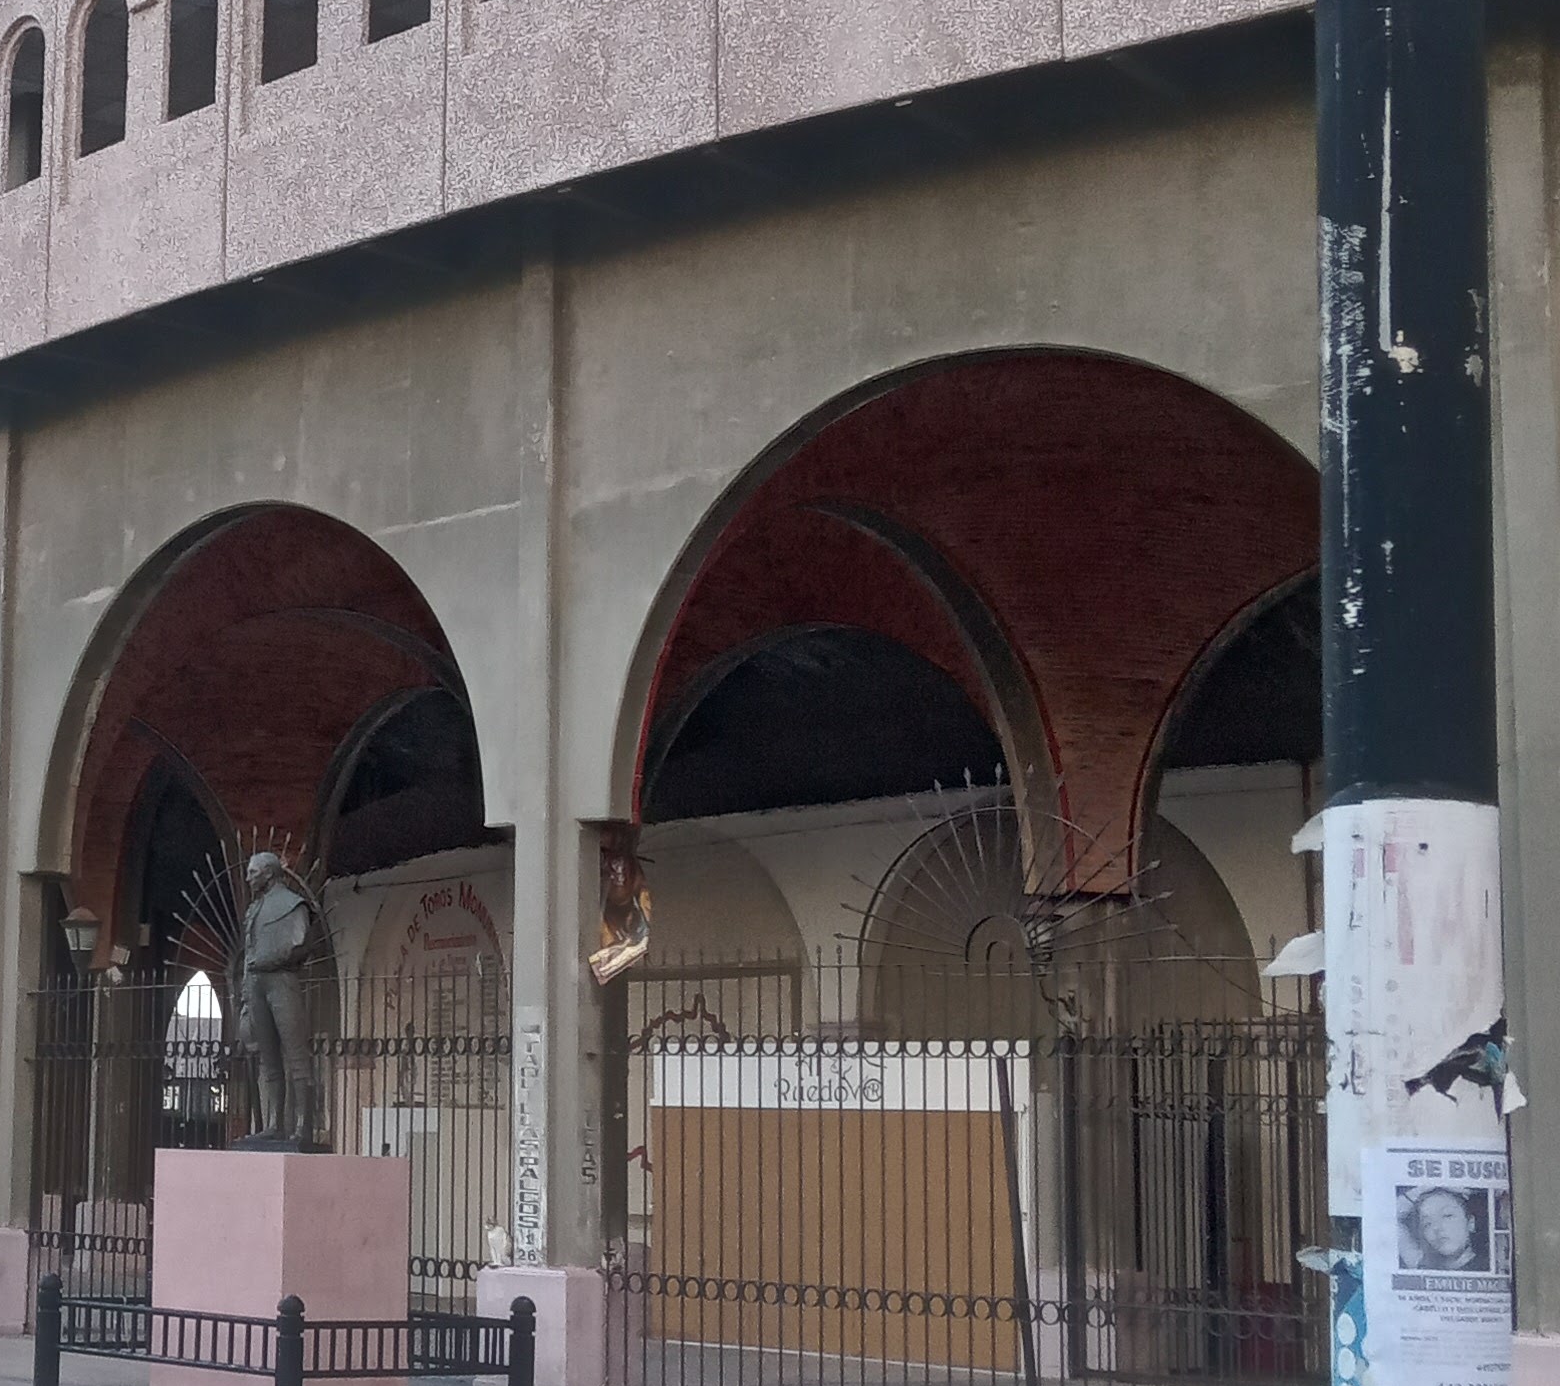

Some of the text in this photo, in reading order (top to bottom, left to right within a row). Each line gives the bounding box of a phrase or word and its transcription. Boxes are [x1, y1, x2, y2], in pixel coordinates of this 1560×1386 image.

[407, 914, 422, 943] DE
[419, 887, 453, 920] TOROS
[1407, 1159, 1443, 1179] SE
[518, 1156, 540, 1229] PALCOS
[518, 1249, 538, 1262] 26
